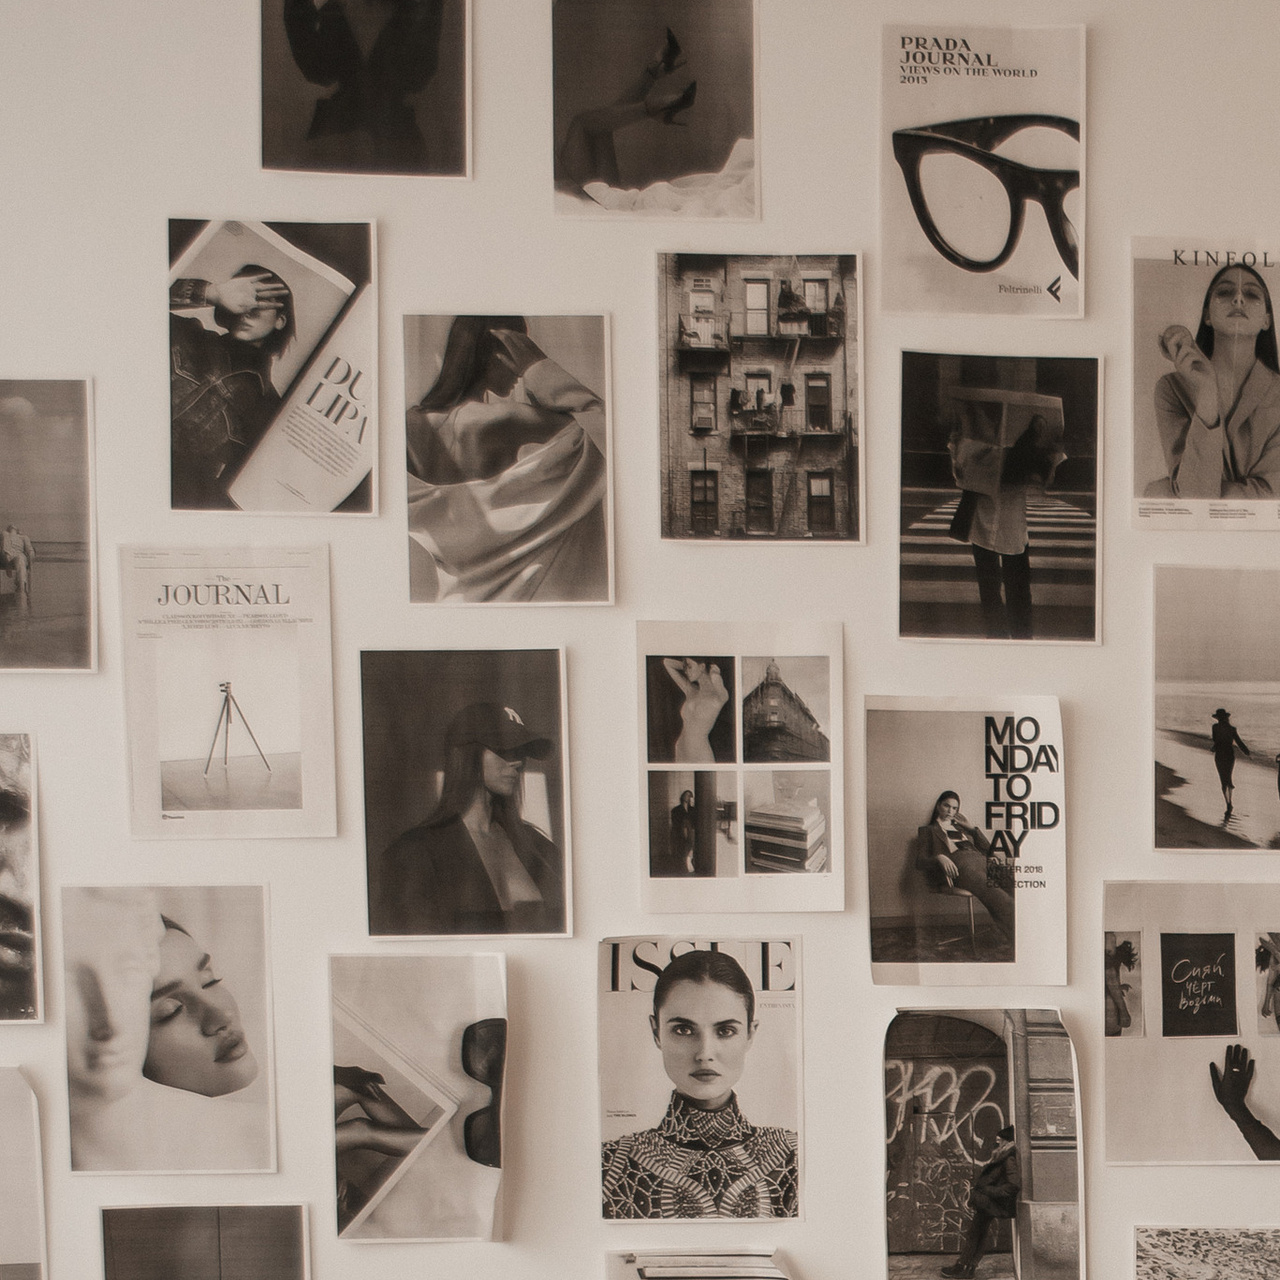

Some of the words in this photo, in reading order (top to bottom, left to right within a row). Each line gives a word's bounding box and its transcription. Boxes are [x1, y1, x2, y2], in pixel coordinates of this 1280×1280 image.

[901, 36, 972, 52] PRADA
[900, 50, 998, 67] JOURNAL
[900, 65, 940, 75] VIEWS
[943, 66, 960, 76] ON
[964, 67, 988, 77] THE
[992, 68, 1038, 78] WORLD
[900, 75, 928, 85] 2013
[998, 284, 1042, 294] Feltrinelli
[215, 575, 232, 583] The
[157, 583, 291, 607] JOURNAL
[985, 716, 1041, 745] MO
[985, 773, 1032, 802] TO
[985, 801, 1060, 830] FRID
[989, 829, 1030, 858] AY
[986, 880, 1046, 889] COECTION
